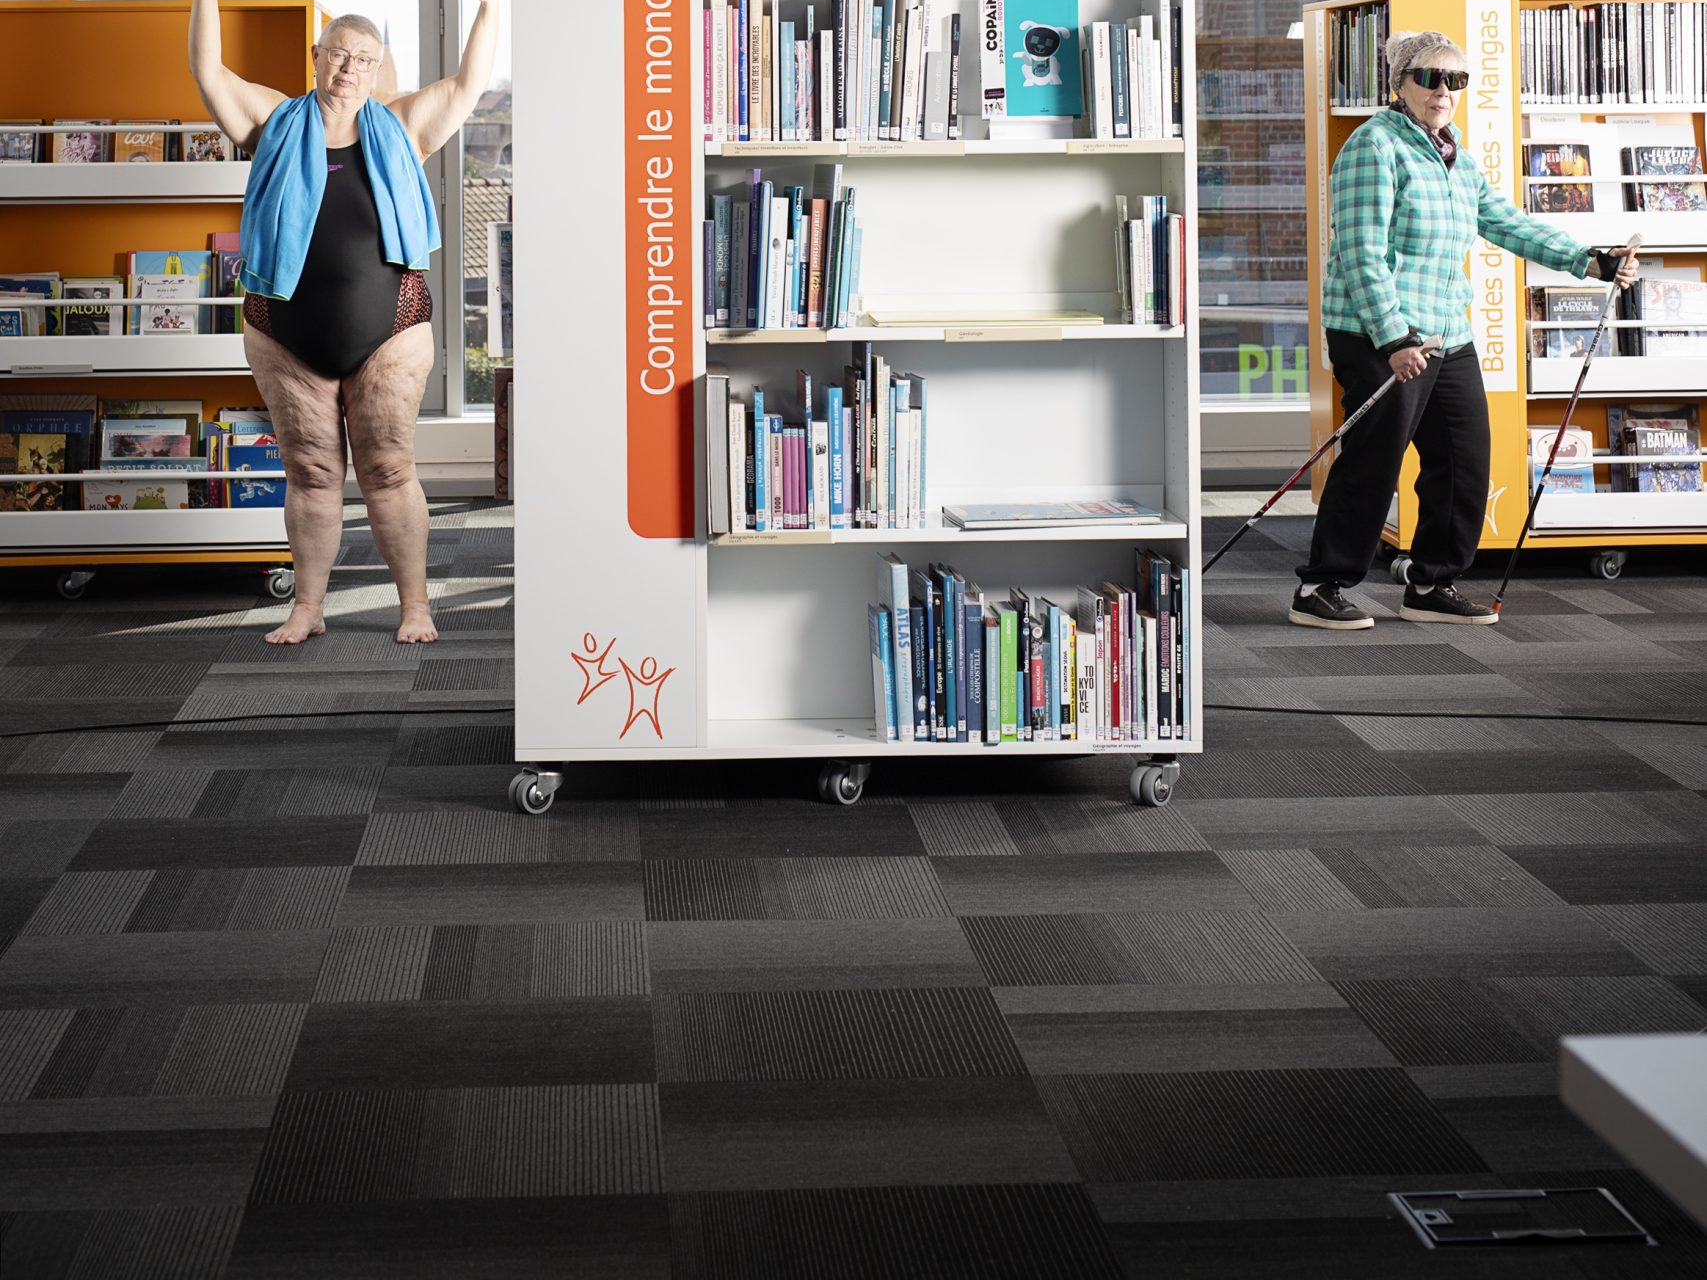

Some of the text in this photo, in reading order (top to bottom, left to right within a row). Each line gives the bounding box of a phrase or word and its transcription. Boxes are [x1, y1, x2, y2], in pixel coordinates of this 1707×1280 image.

[716, 29, 725, 51] EXISTE
[752, 26, 760, 64] INCROYABLES
[716, 64, 725, 89] QUAND
[752, 65, 760, 77] DES
[838, 61, 844, 72] DE
[882, 61, 890, 85] SIÈCLE
[752, 79, 760, 95] LIVRE
[906, 70, 914, 97] DRONES
[716, 91, 725, 115] DEPUIS
[637, 110, 673, 140] le
[1648, 149, 1696, 158] JUSTICE
[1651, 156, 1691, 165] LEAGUE
[1477, 10, 1505, 373] Bandes Mangas
[812, 209, 820, 268] CHOSES INCROYABLES
[637, 157, 682, 395] Comprendre
[65, 305, 112, 315] JALOUX
[12, 422, 82, 433] ORPHÉE
[1646, 432, 1688, 448] BATMAN
[746, 454, 755, 484] GÉORAMA
[833, 454, 842, 480] HORN
[833, 482, 842, 504] MIKE
[774, 497, 782, 514] 1000
[896, 608, 910, 704] ATLAS géographique
[1160, 611, 1170, 693] MAROC ÉMOTIONS COULEURS
[1176, 644, 1182, 653] 66
[936, 671, 944, 694] Europe
[973, 648, 981, 704] COMPOSTELLE
[1085, 666, 1094, 677] TO
[1079, 678, 1094, 689] KYO
[1079, 690, 1089, 701] VI
[1079, 702, 1089, 714] CE
